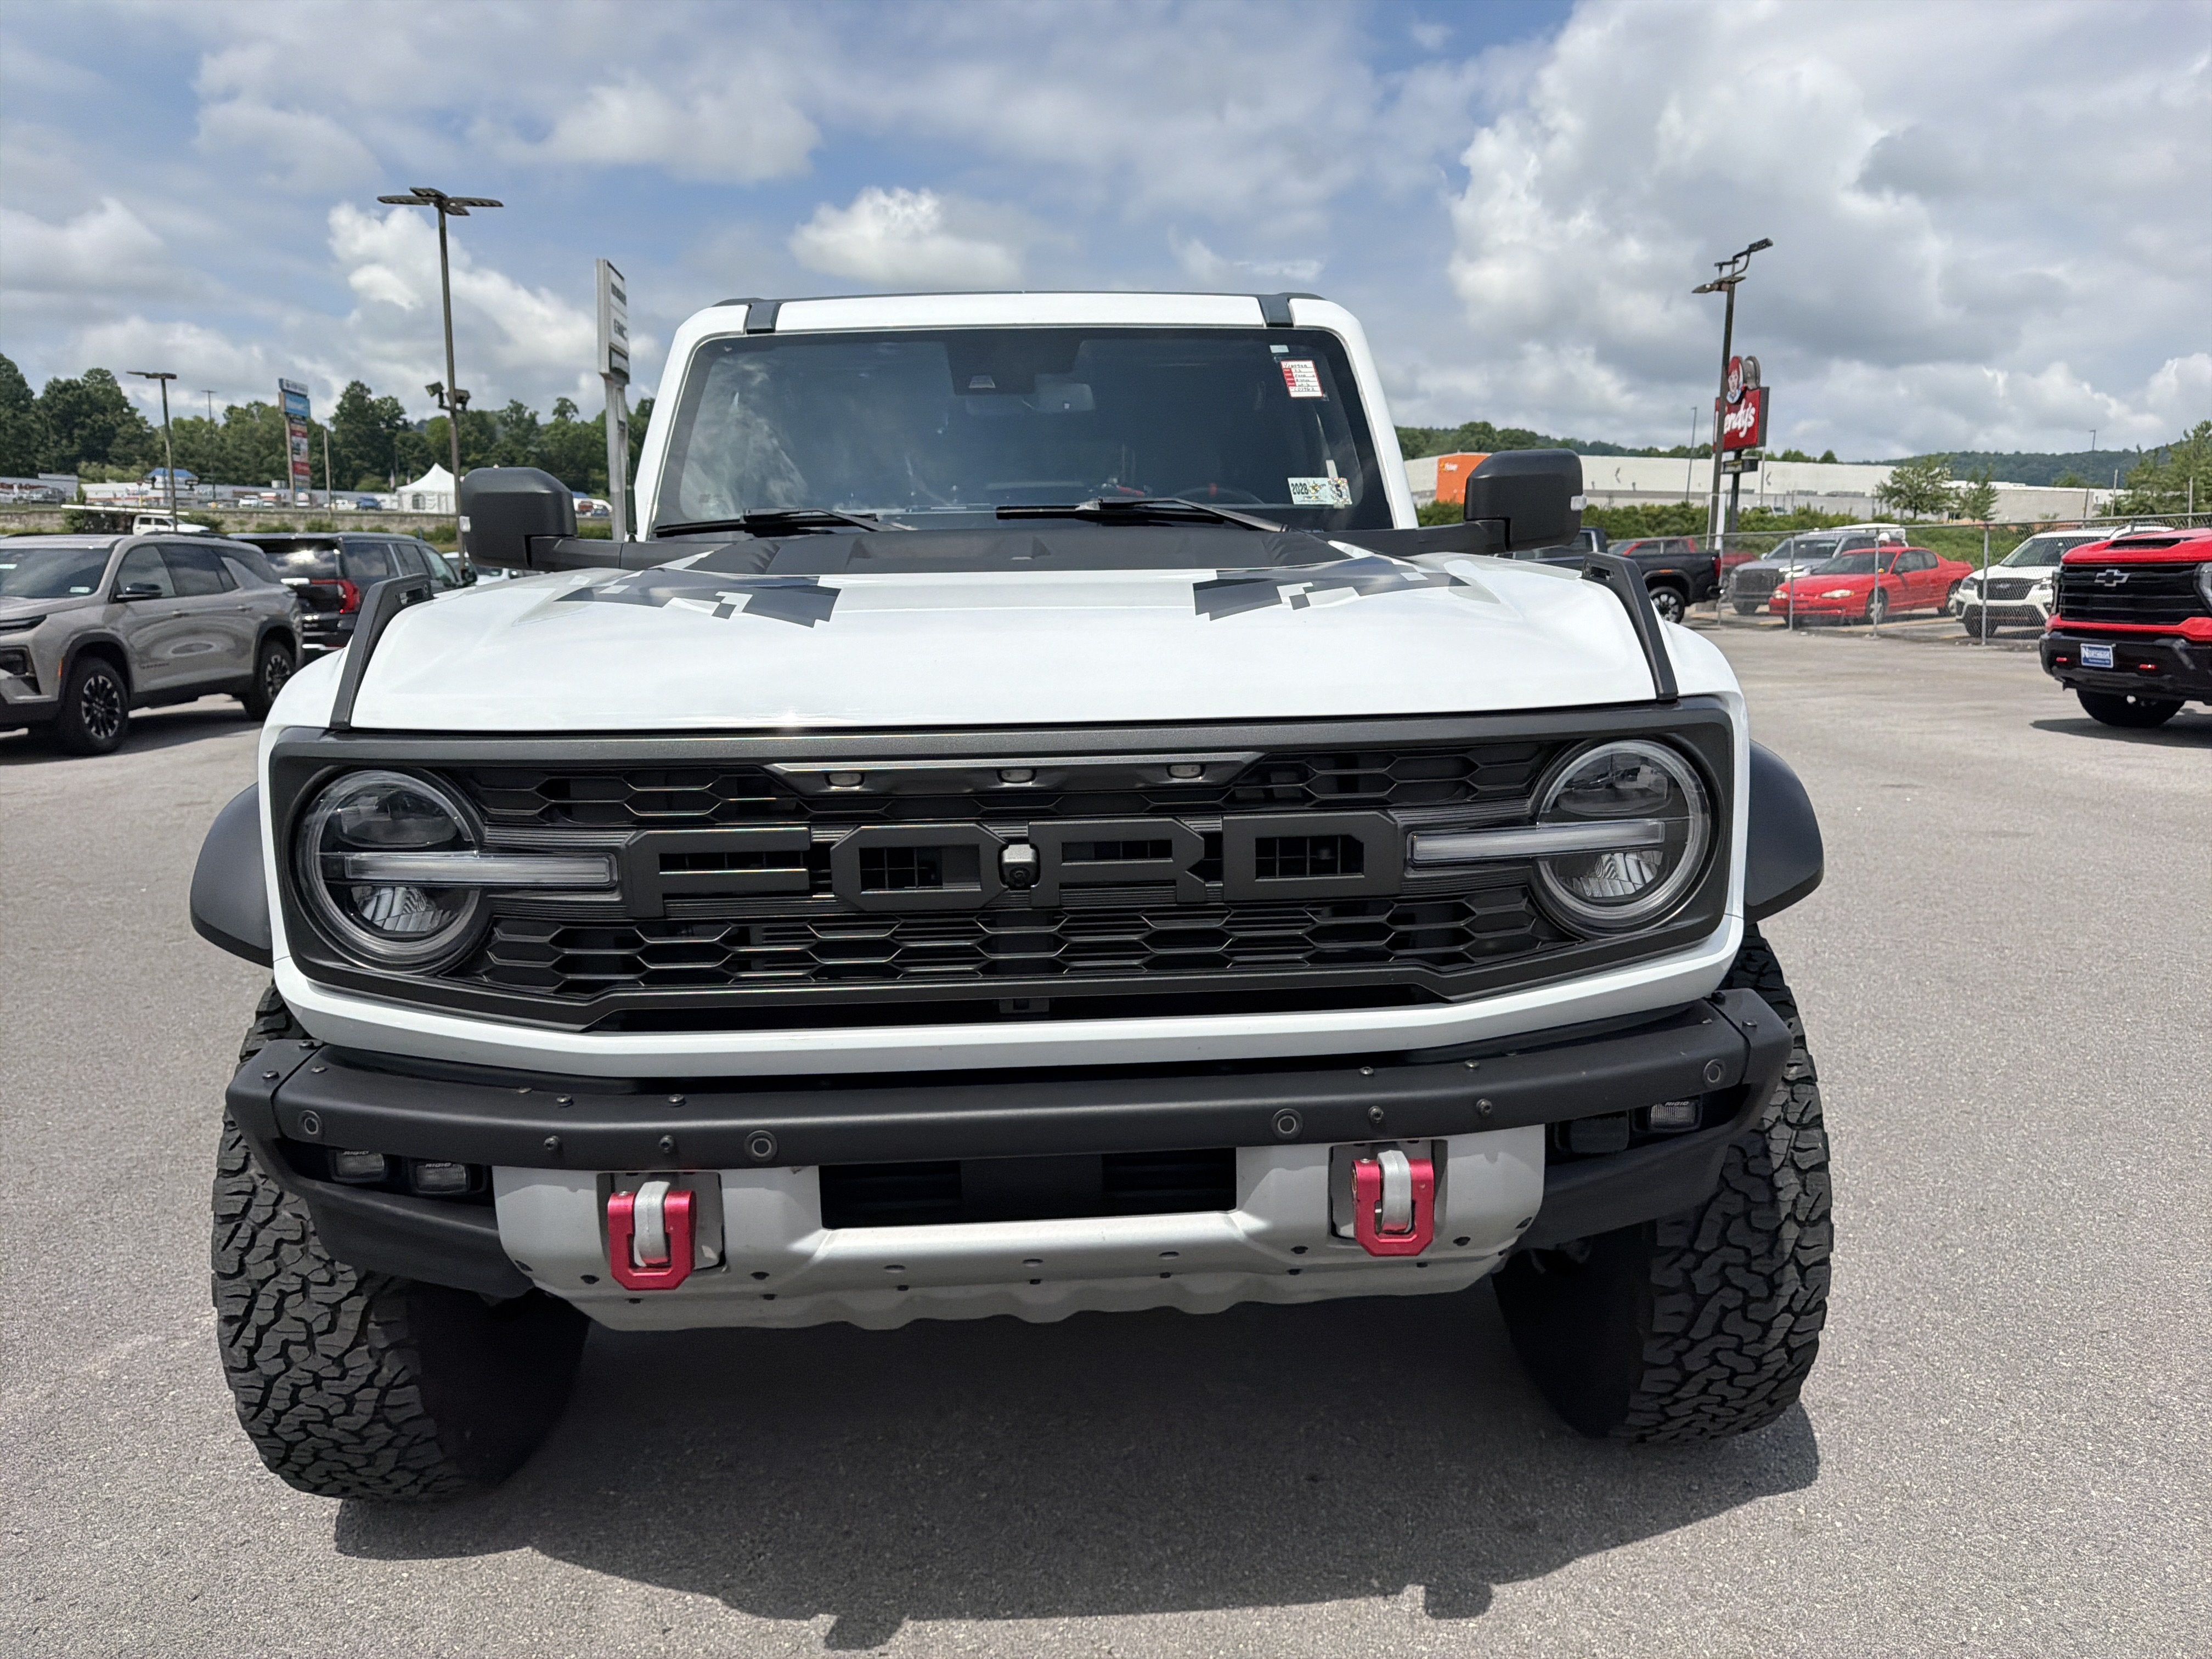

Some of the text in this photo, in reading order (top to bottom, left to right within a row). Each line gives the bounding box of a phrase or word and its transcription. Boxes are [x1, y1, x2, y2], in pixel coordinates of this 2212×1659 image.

[1715, 399, 1756, 441] endy's
[1291, 483, 1309, 495] 2028
[625, 810, 1403, 917] FORD
